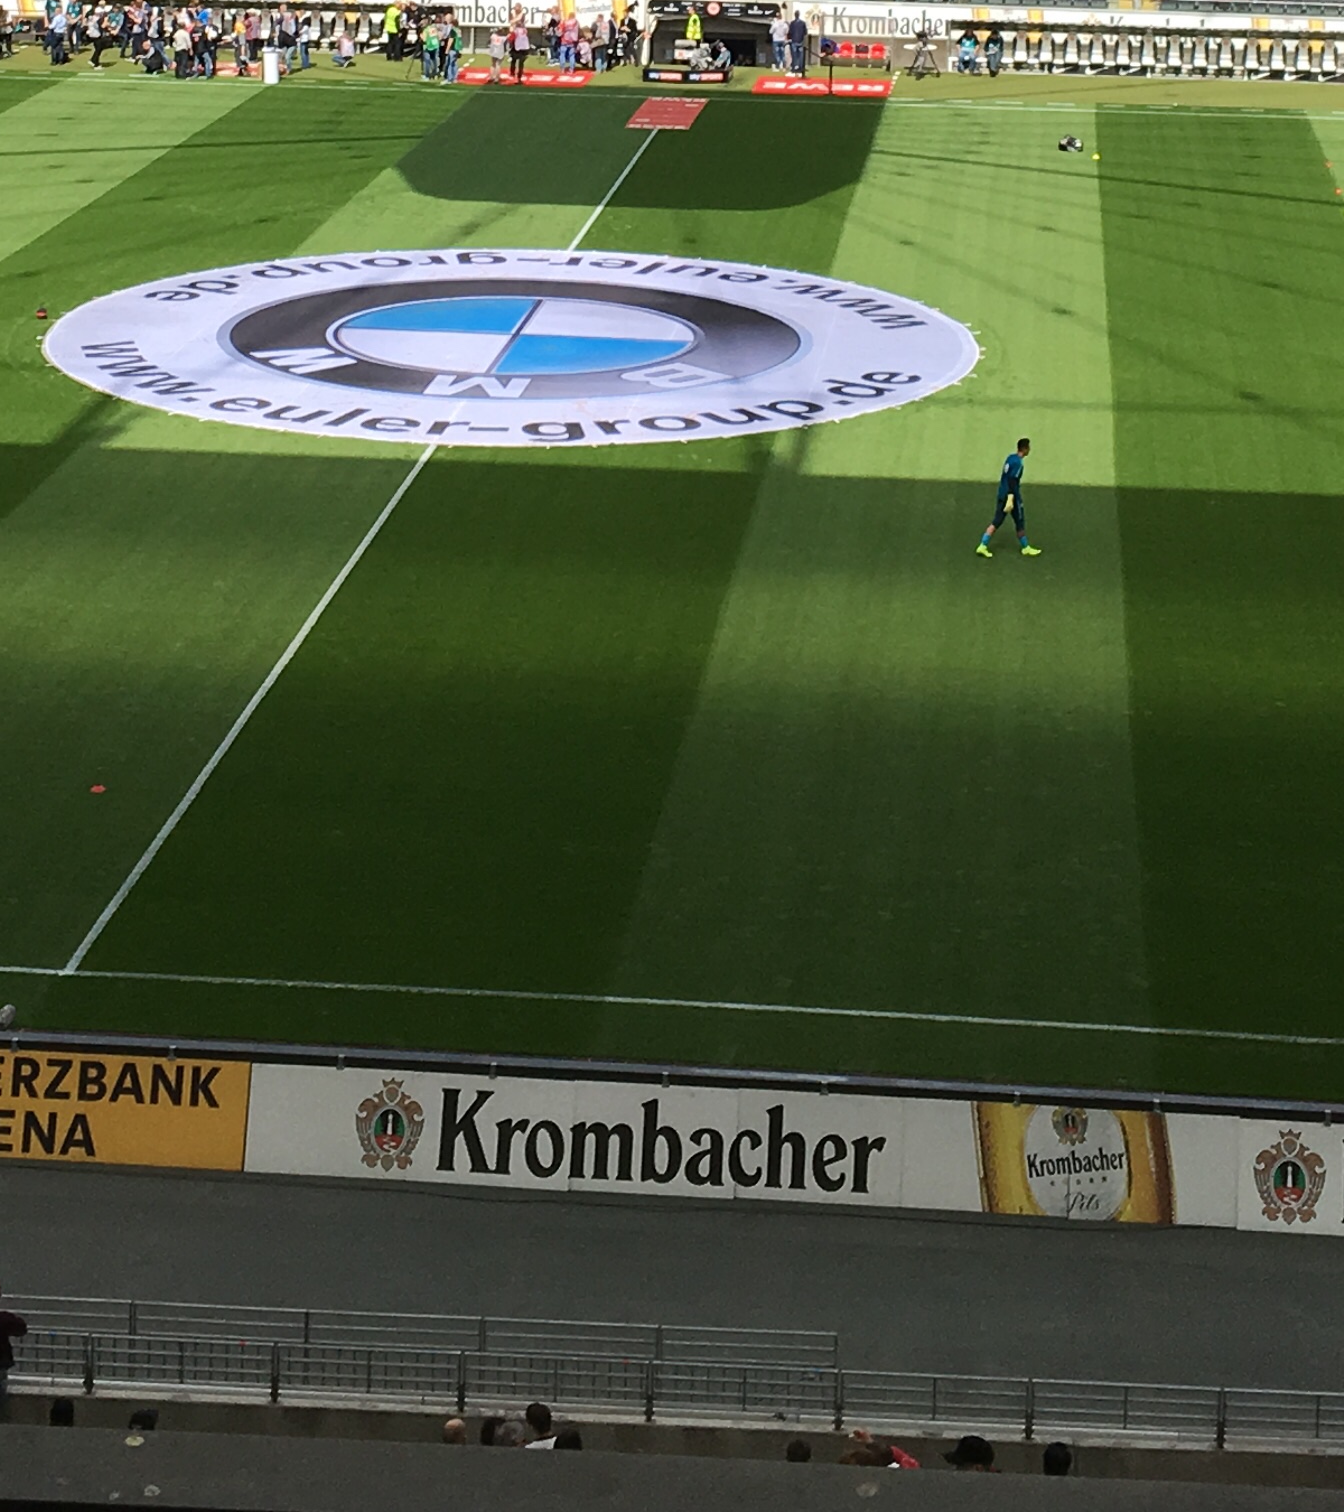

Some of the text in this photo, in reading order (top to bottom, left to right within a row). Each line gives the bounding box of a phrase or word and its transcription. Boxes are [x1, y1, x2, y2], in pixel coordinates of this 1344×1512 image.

[82, 338, 921, 444] www.euler-group.de
[437, 1087, 887, 1194] Krombacher
[1026, 1147, 1125, 1179] Krombacher
